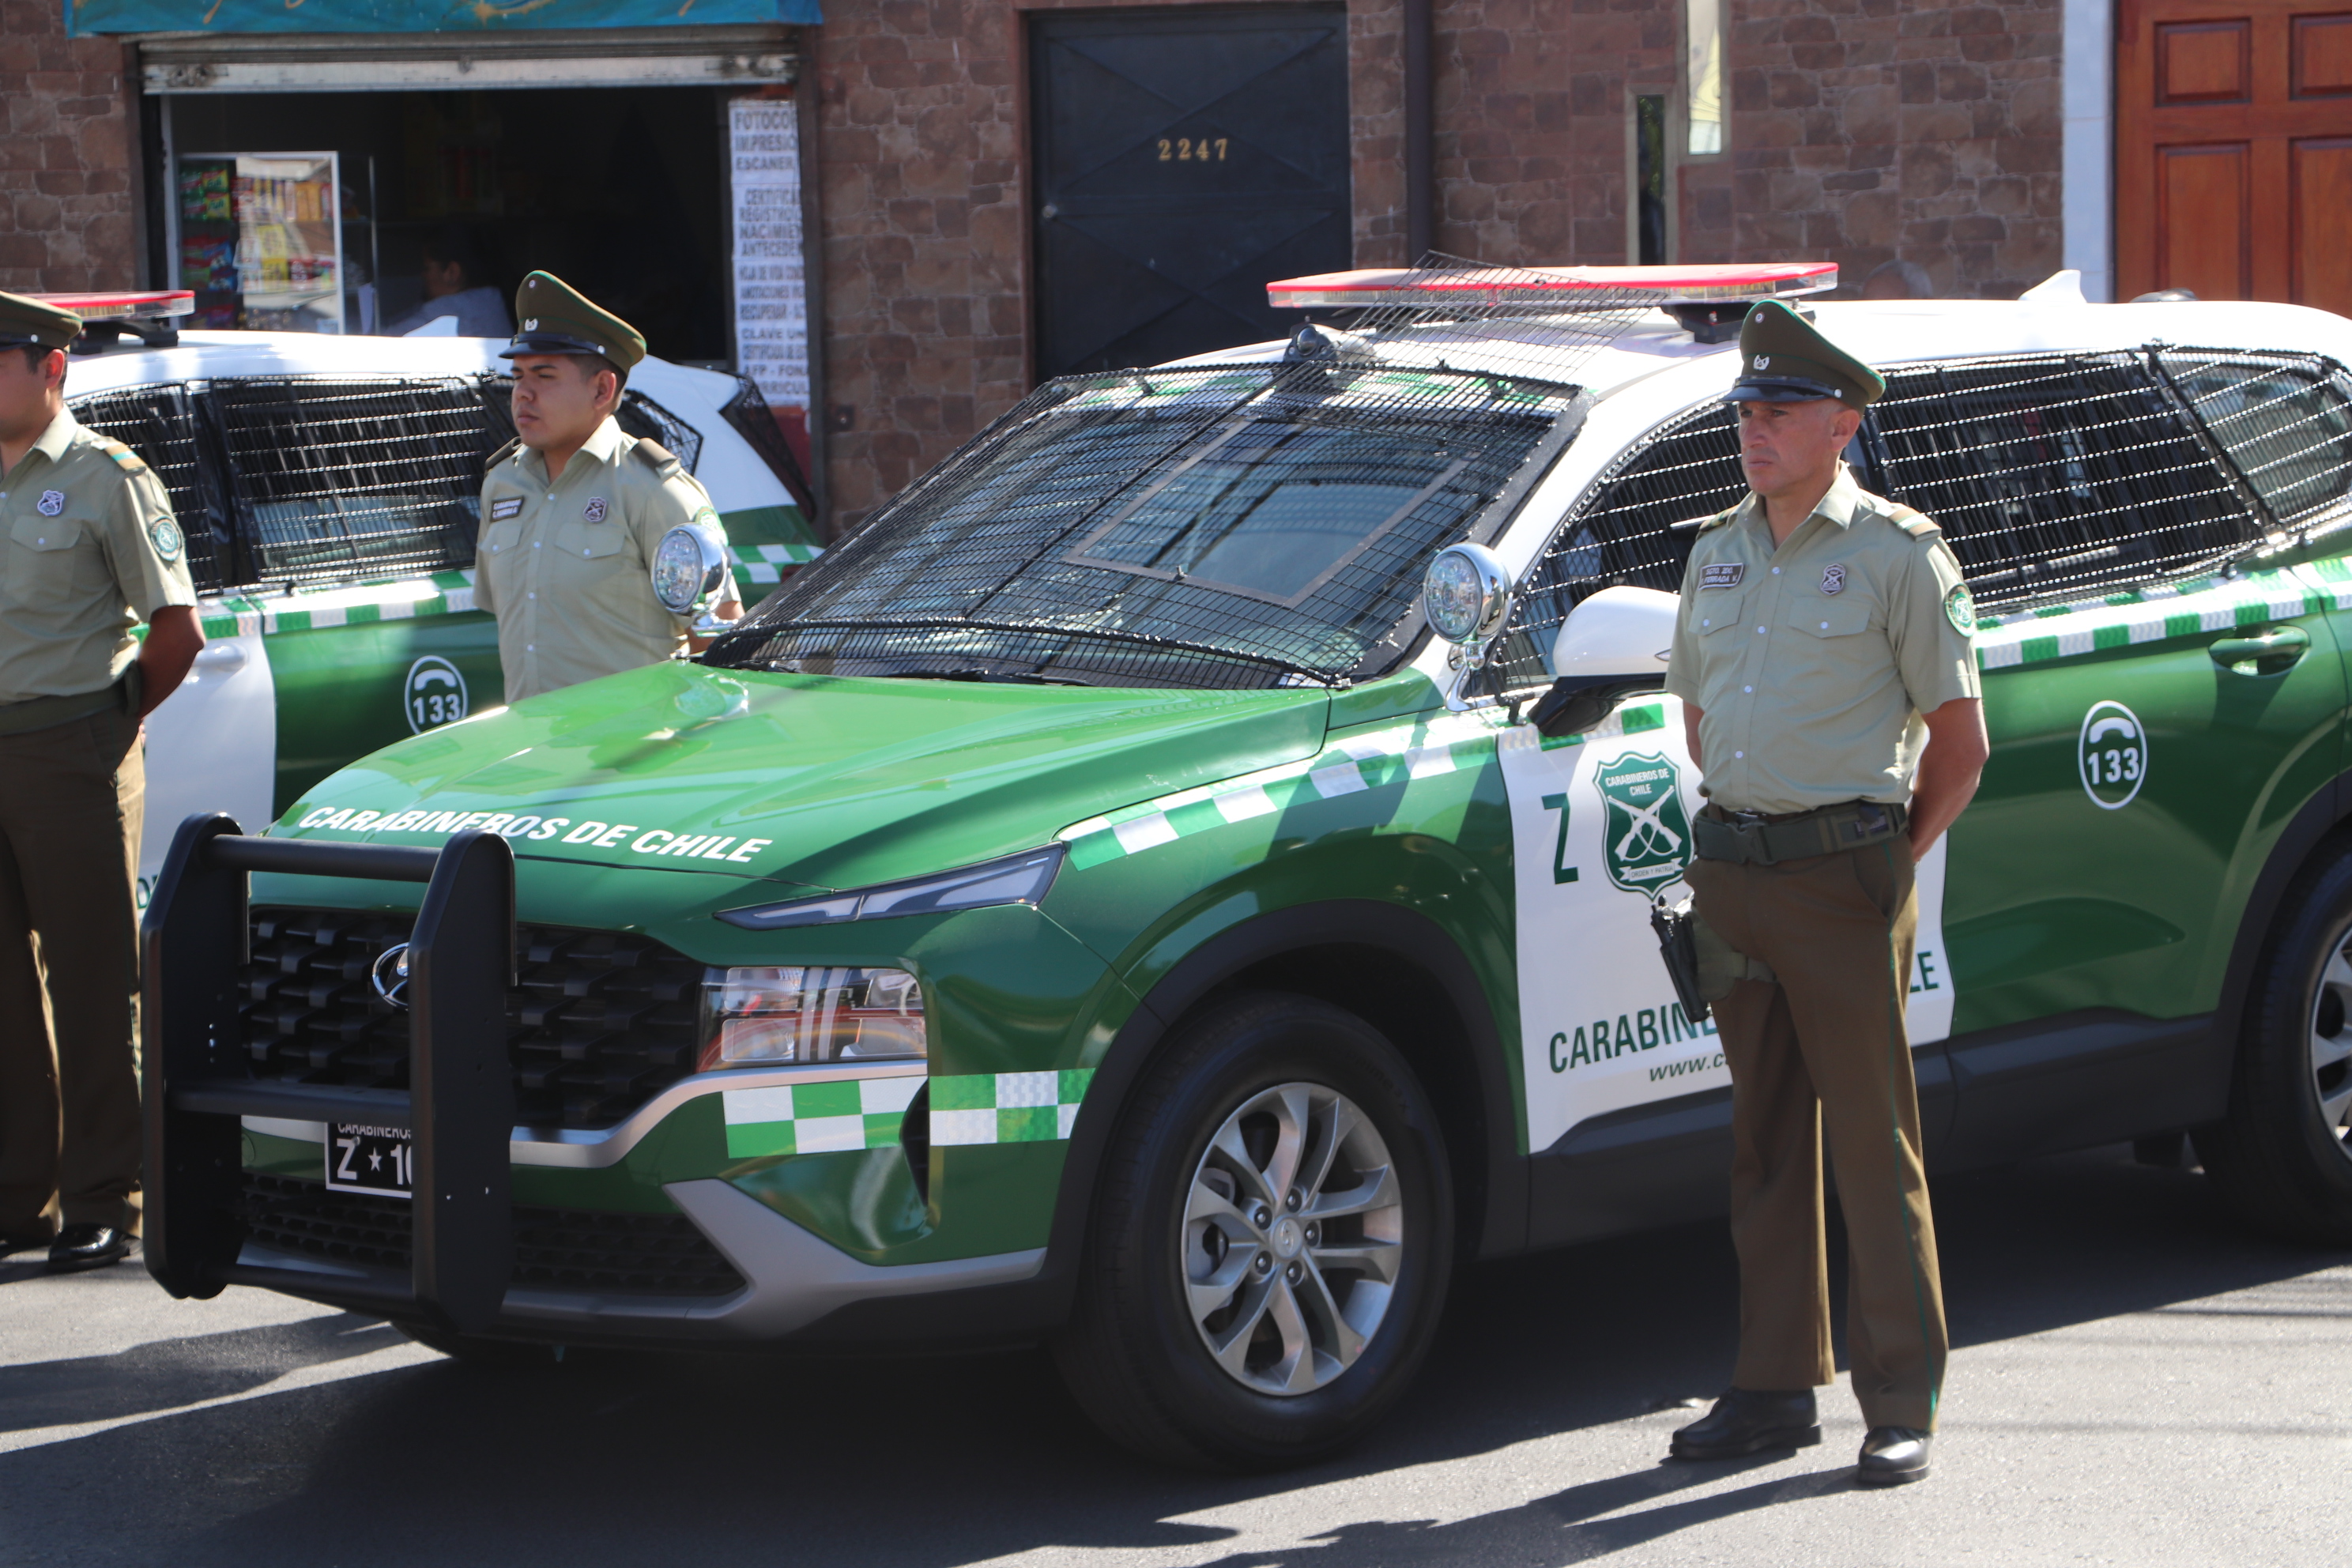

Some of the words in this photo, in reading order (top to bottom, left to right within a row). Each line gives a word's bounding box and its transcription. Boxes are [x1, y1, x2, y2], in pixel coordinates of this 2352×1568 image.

[1157, 138, 1227, 161] 2247
[413, 693, 461, 725] 133
[1605, 770, 1658, 787] CARABINEROS
[1658, 767, 1670, 779] DE
[2087, 747, 2139, 785] 133
[1629, 783, 1652, 796] CHILE
[299, 806, 571, 840] CARABINEROS
[561, 820, 639, 848] DE
[631, 829, 773, 863] CHILE
[1542, 792, 1579, 884] Z
[1649, 1053, 1728, 1082] www.c
[337, 1138, 357, 1181] Z
